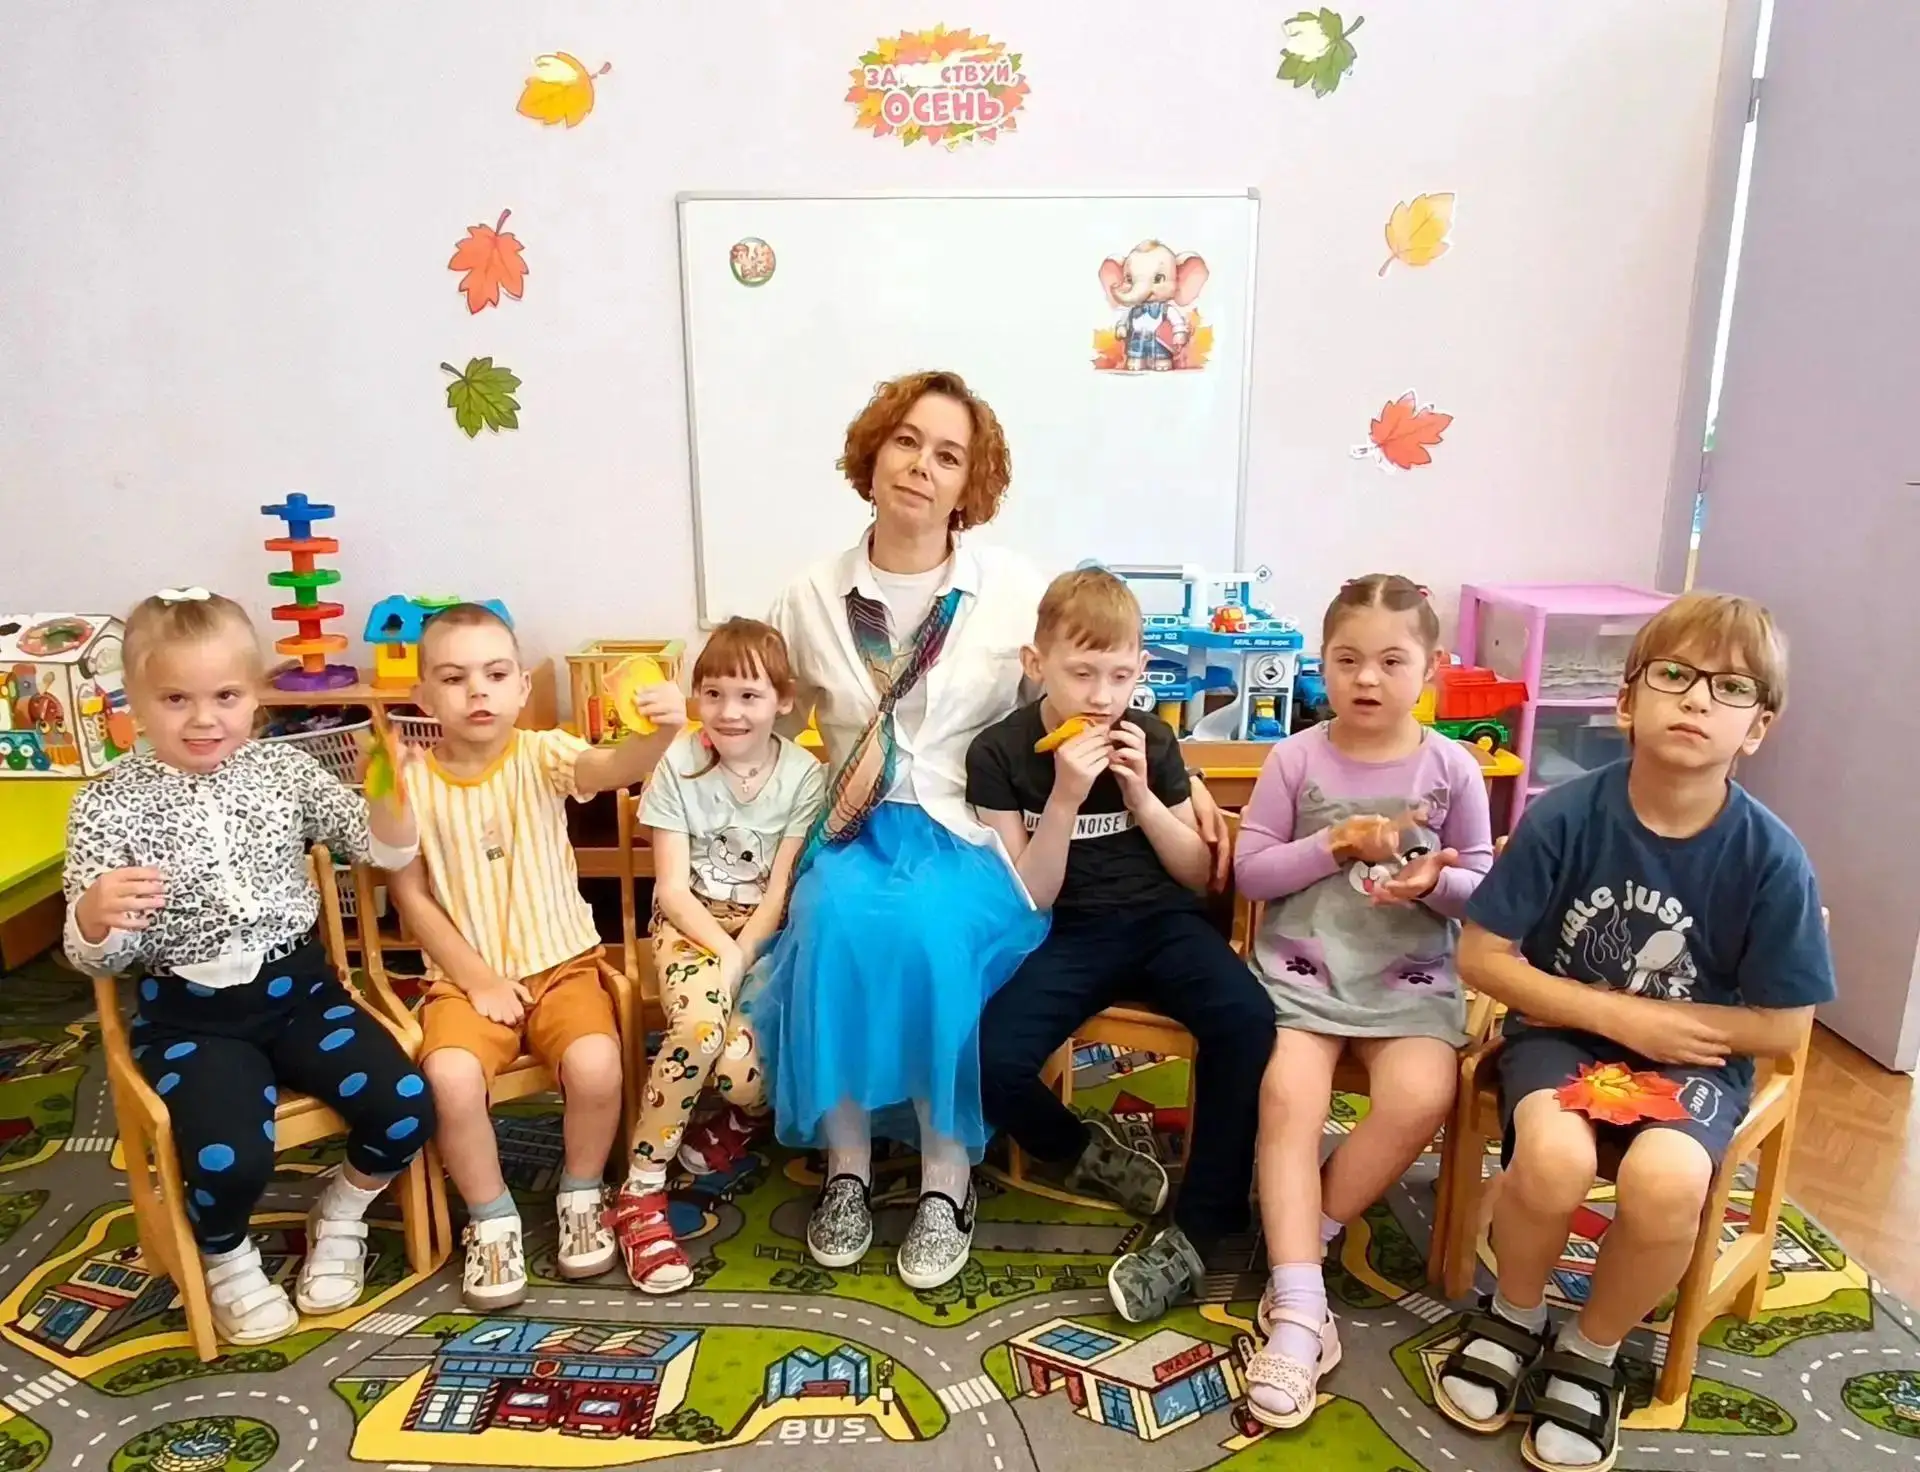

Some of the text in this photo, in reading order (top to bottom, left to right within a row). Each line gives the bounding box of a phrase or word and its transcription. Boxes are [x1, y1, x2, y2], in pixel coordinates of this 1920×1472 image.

[866, 59, 1016, 87] ЗДСТВУЙ,
[884, 91, 1001, 123] ОСЕНЬ
[1076, 815, 1121, 835] NOISE
[1689, 1084, 1709, 1114] RIDE
[778, 1417, 866, 1440] BUS
